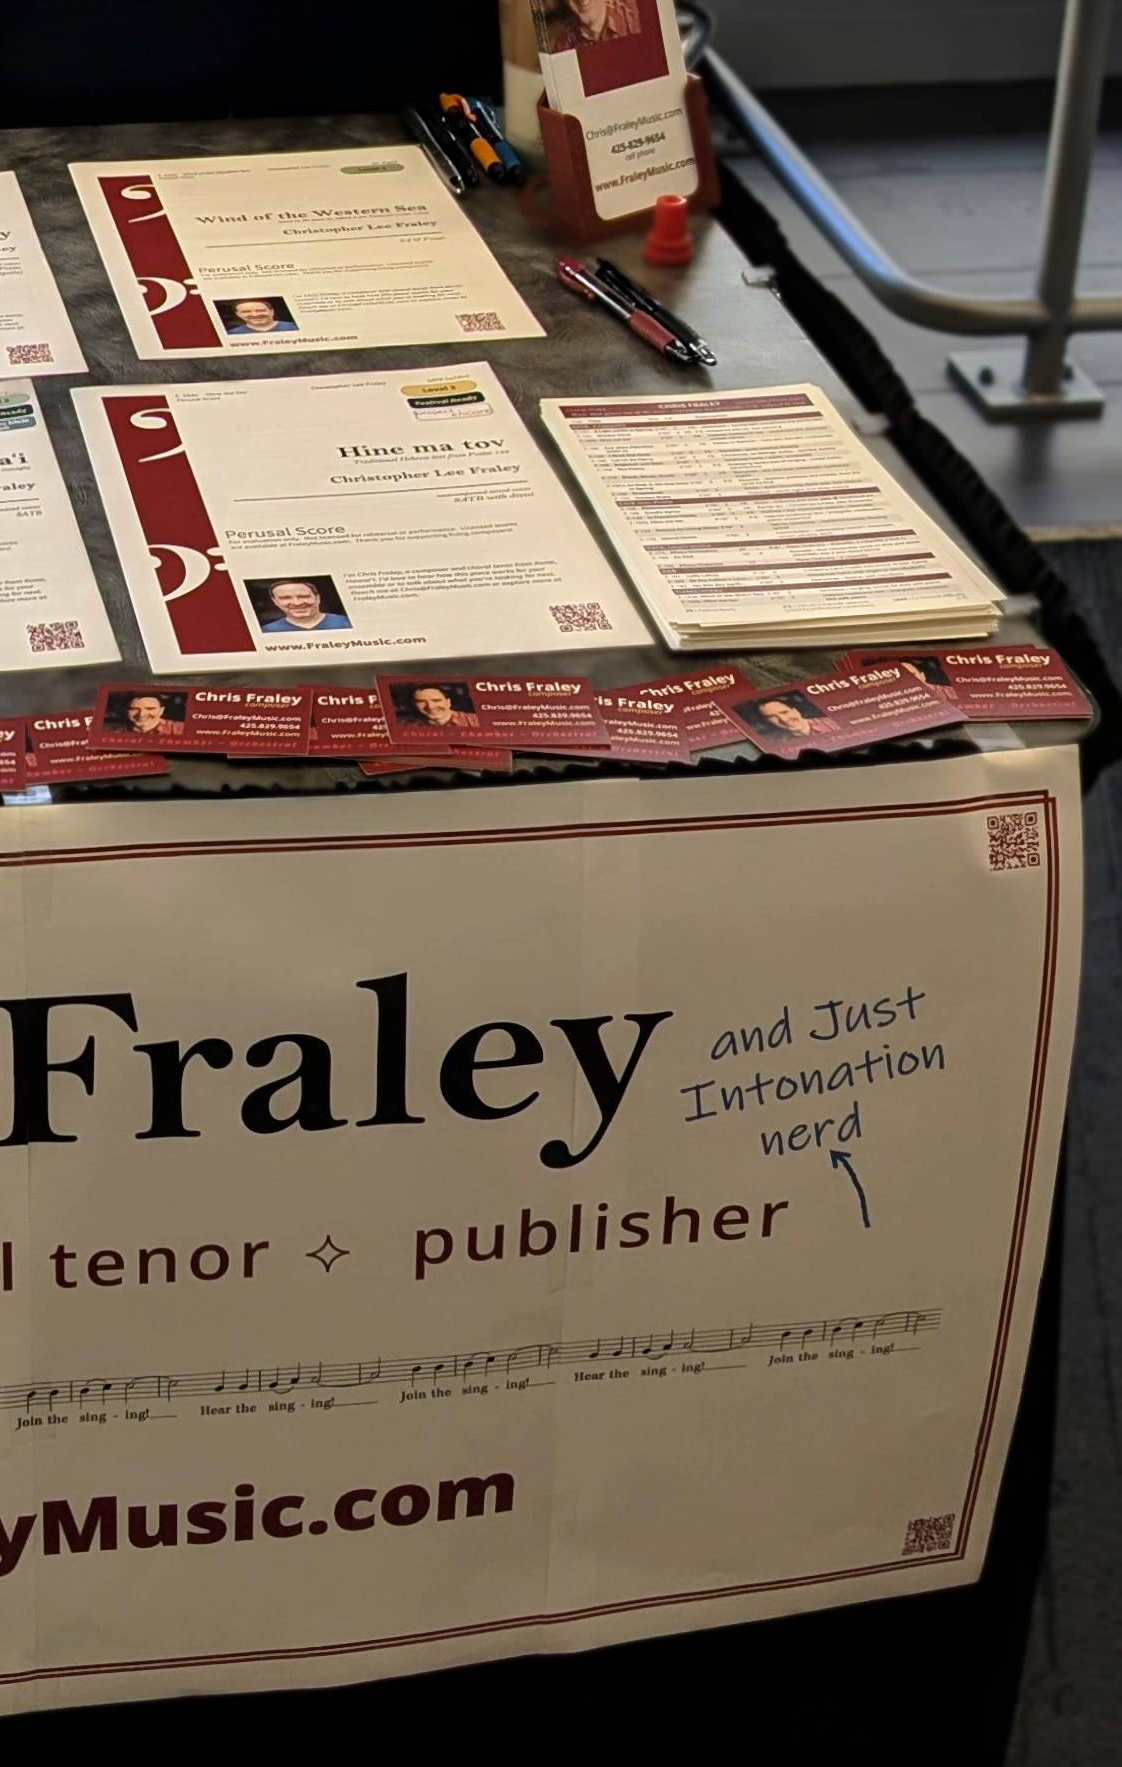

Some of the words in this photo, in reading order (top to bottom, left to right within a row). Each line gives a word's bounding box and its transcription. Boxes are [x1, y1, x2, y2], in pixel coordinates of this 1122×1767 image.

[586, 108, 683, 141] Chris@FraleyMusic.com
[594, 157, 696, 192] www.FraleyMusic.com
[195, 215, 248, 225] Wind
[253, 213, 273, 221] of
[278, 212, 308, 220] the
[312, 207, 391, 218] Western
[394, 204, 428, 212] Sea
[282, 225, 365, 236] Christopher
[396, 220, 438, 228] Fraley
[336, 445, 405, 458] Hine
[412, 443, 453, 453] ma
[462, 438, 506, 450] tov
[330, 471, 430, 484] Christopher
[434, 469, 465, 478] Lee
[469, 463, 522, 475] Fraley
[225, 527, 291, 540] Perusal
[294, 524, 347, 536] Score
[264, 635, 427, 653] www.FraleyMusic.com
[945, 654, 993, 666] Chris
[994, 654, 1052, 666] Fraley
[475, 681, 522, 693] Chris
[525, 682, 582, 694] Fraley
[687, 673, 737, 692] Fraley
[806, 677, 851, 696] Chris
[849, 666, 902, 688] Fraley
[195, 692, 242, 704] Chris
[246, 693, 303, 706] Fraley
[317, 695, 365, 707] Chris
[617, 698, 675, 714] Fraley
[34, 717, 80, 731] Chris
[710, 1005, 793, 1061] and
[808, 986, 926, 1041] Just
[680, 1044, 945, 1123] Intonation
[760, 1100, 862, 1156] nerd
[49, 1233, 271, 1290] tenor
[414, 1194, 790, 1281] publisher
[15, 1416, 43, 1430] Join
[48, 1413, 68, 1425] the
[200, 1405, 231, 1417] Hear
[236, 1403, 256, 1414] the
[400, 1390, 426, 1404] Join
[431, 1388, 452, 1398] the
[574, 1371, 605, 1382] Hear
[609, 1369, 629, 1379] the
[767, 1353, 794, 1367] Join
[798, 1351, 819, 1362] the
